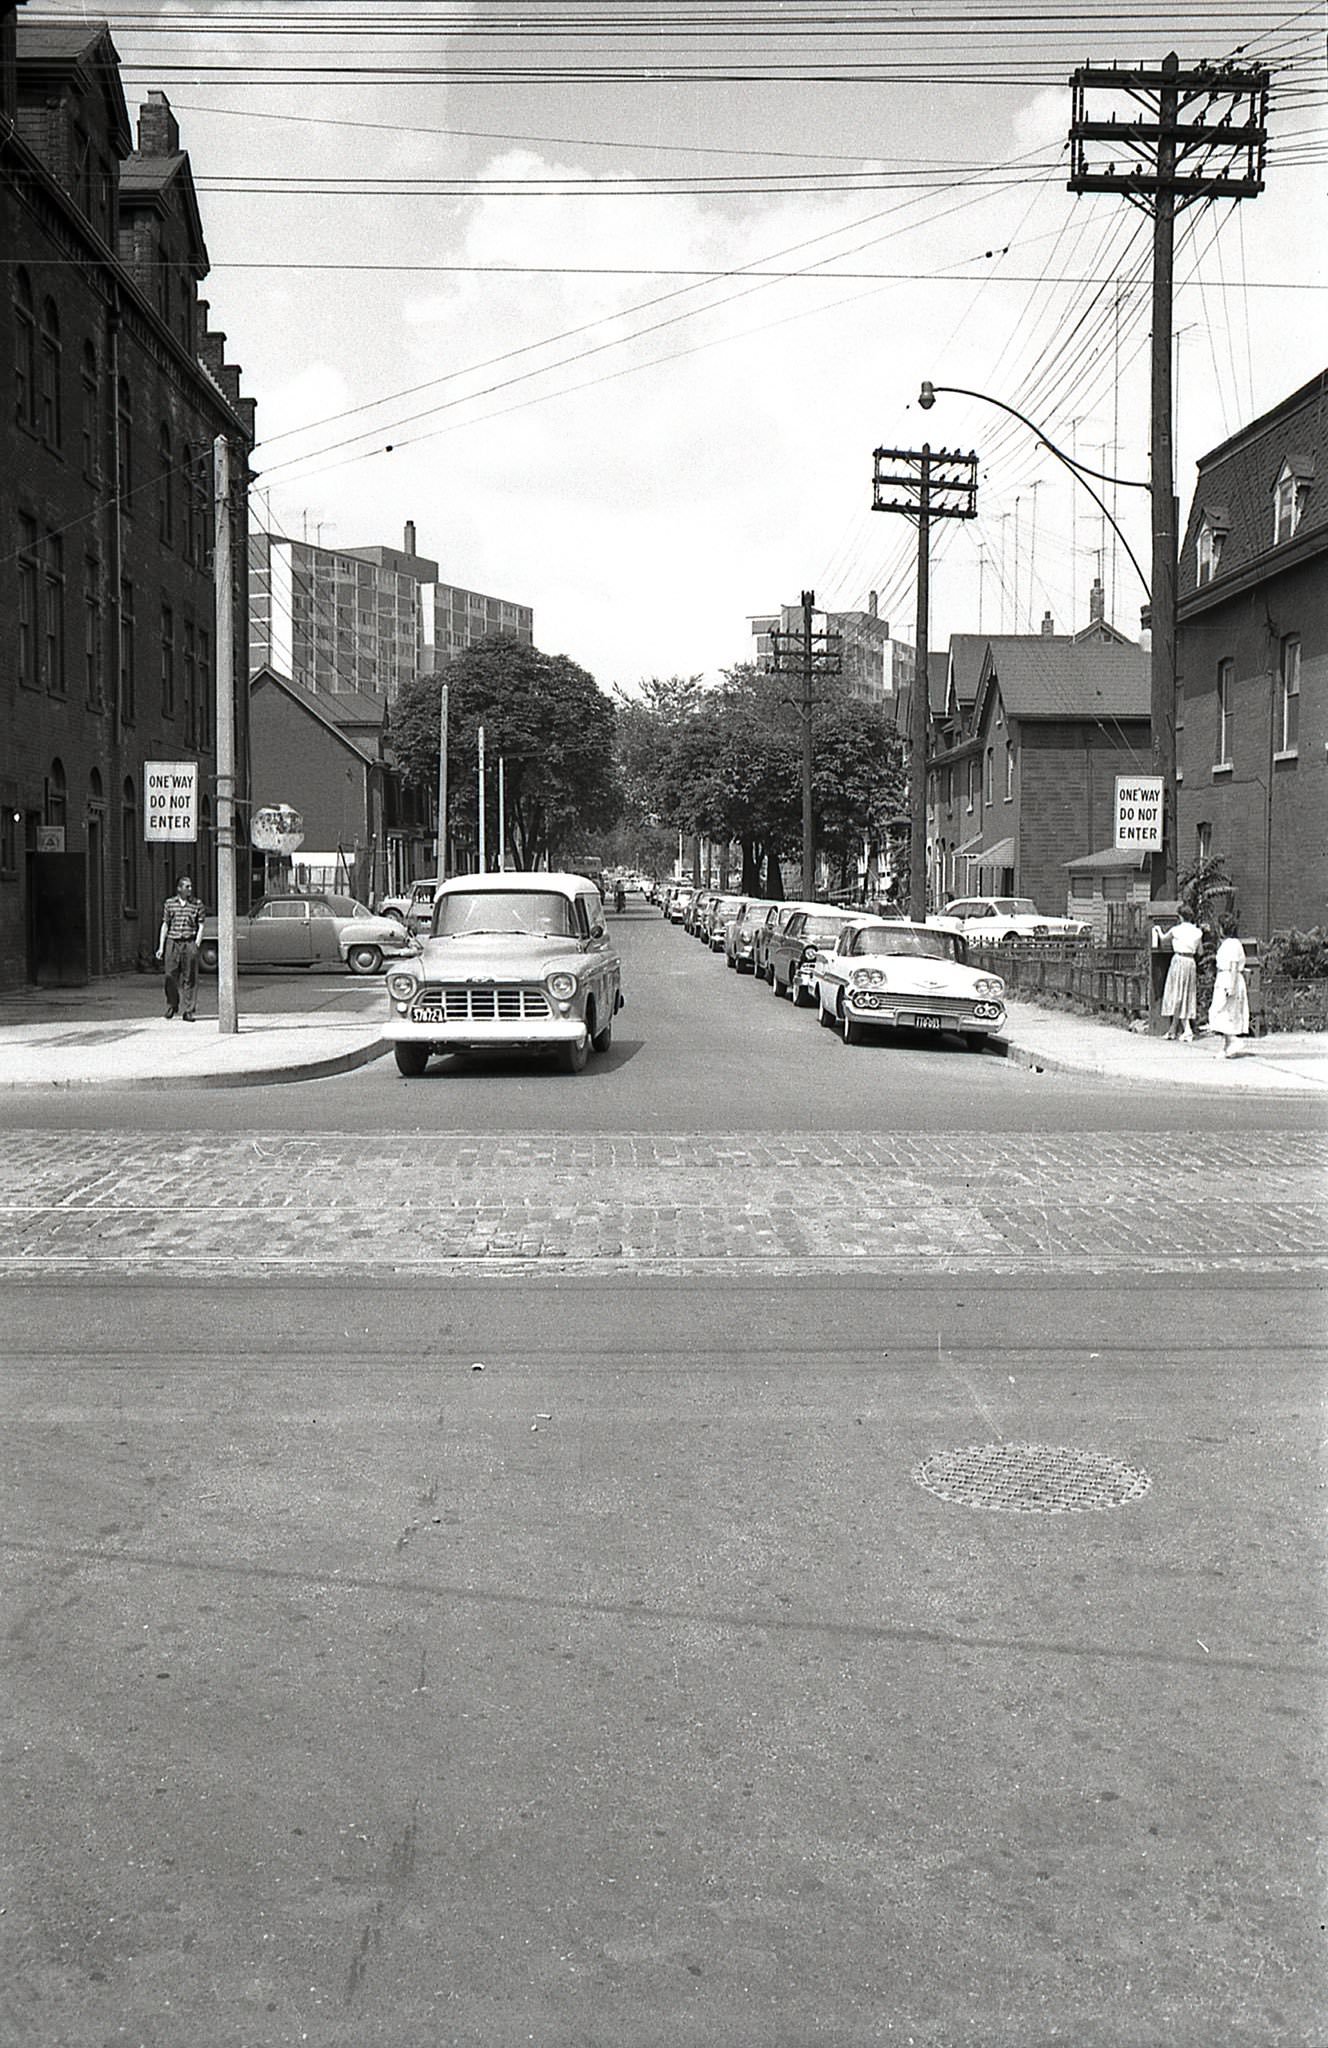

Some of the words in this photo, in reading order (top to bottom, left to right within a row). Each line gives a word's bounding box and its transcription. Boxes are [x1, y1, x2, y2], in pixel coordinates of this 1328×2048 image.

[149, 775, 169, 788] ONE
[172, 775, 194, 788] WAY
[1119, 788, 1138, 801] ONE
[1140, 789, 1160, 801] WAY
[150, 795, 166, 809] DO
[169, 795, 191, 809] NOT
[1120, 808, 1135, 820] DO
[1138, 808, 1158, 820] NOT
[150, 815, 191, 830] ENTER
[1119, 827, 1157, 840] ENTER
